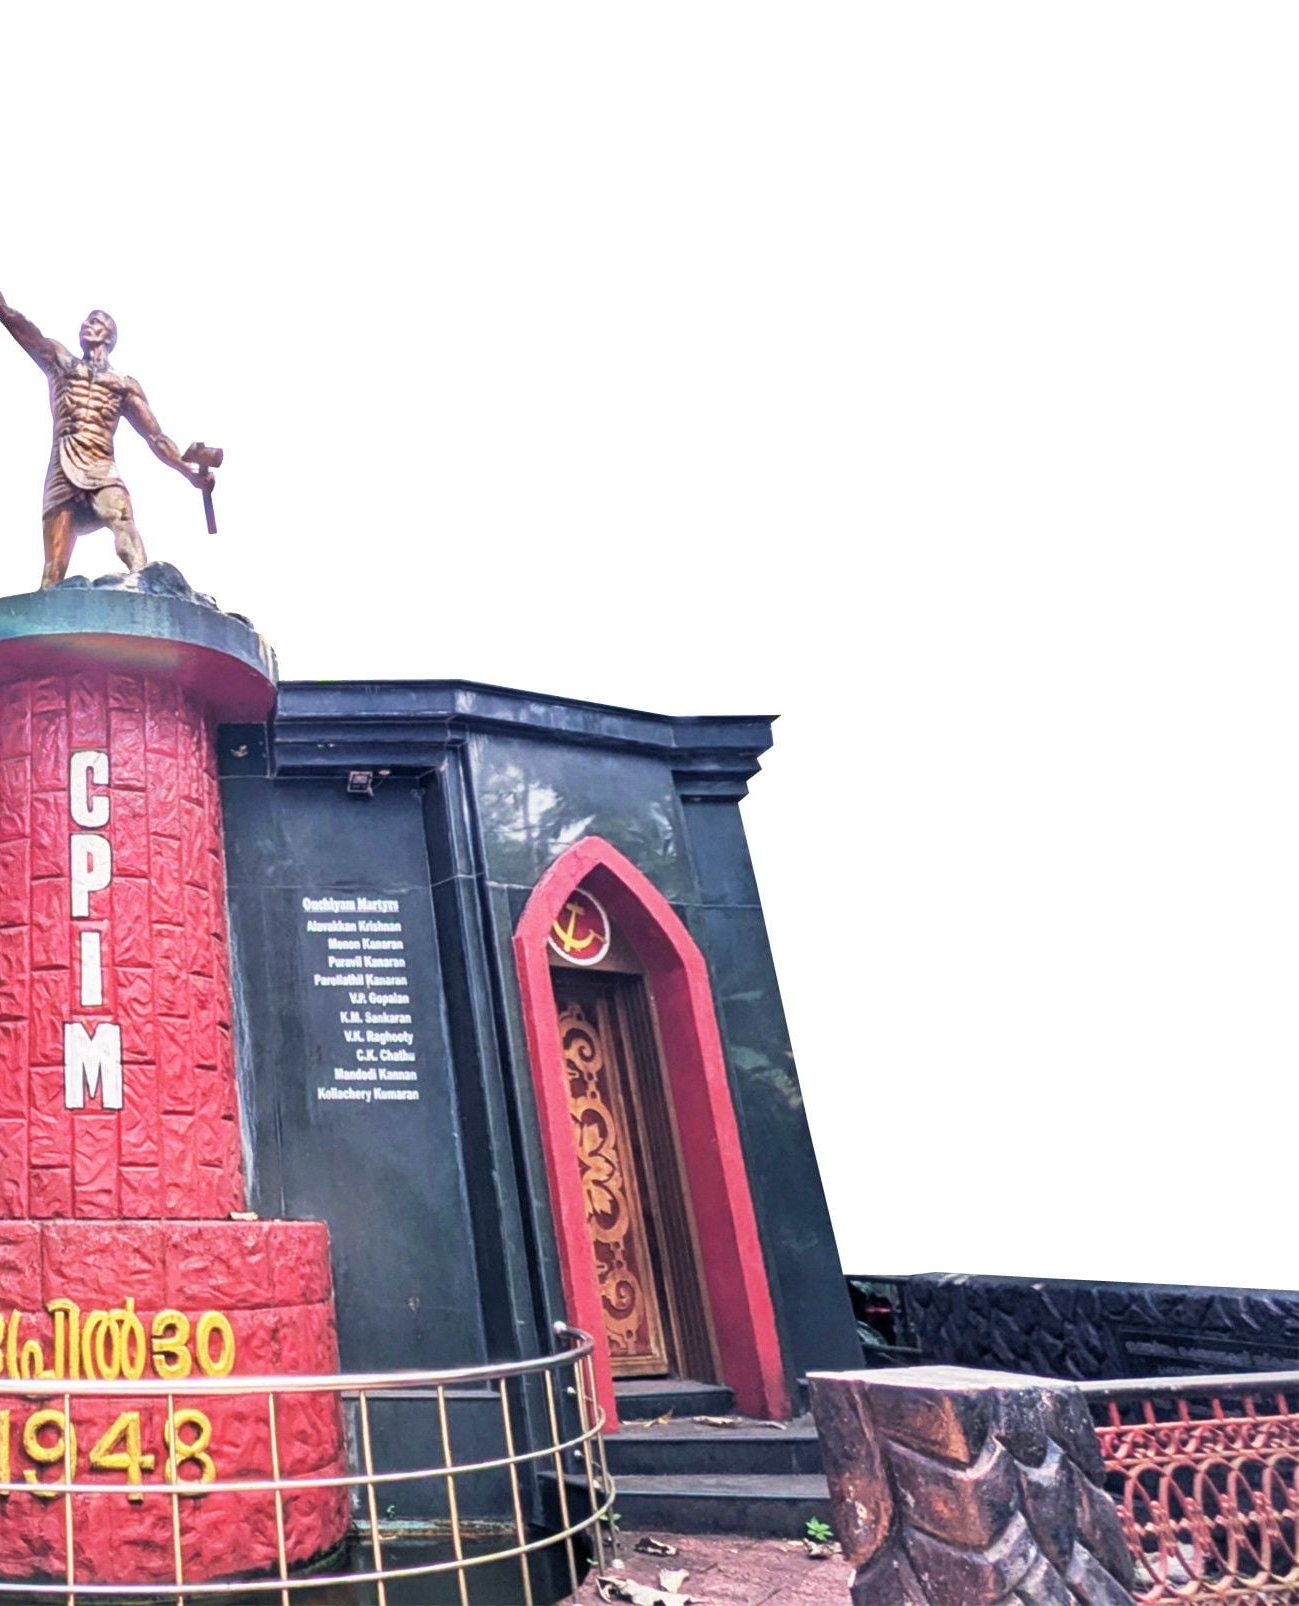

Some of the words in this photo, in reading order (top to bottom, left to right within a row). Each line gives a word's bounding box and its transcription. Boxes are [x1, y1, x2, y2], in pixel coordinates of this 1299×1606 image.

[302, 897, 356, 913] Onchiyam
[357, 897, 399, 913] Martyrs
[63, 749, 124, 1110] CPIM
[358, 920, 402, 932] Krishnan
[328, 938, 360, 950] Menon
[362, 938, 404, 950] Kanaran
[328, 955, 362, 968] Puravil
[364, 955, 406, 968] Kanaran
[365, 974, 408, 986] Kanaran
[349, 991, 367, 1004] V.P.
[368, 991, 409, 1007] Gopalan
[340, 1011, 363, 1024] K.M.
[365, 1011, 412, 1024] Sankaran
[344, 1030, 365, 1043] V.K.
[356, 1049, 378, 1061] C.K.
[379, 1049, 416, 1061] Chathu
[334, 1068, 377, 1081] Mandodi
[378, 1068, 418, 1081] Kannan
[373, 1087, 419, 1100] Kumaran
[152, 1308, 236, 1380] 30
